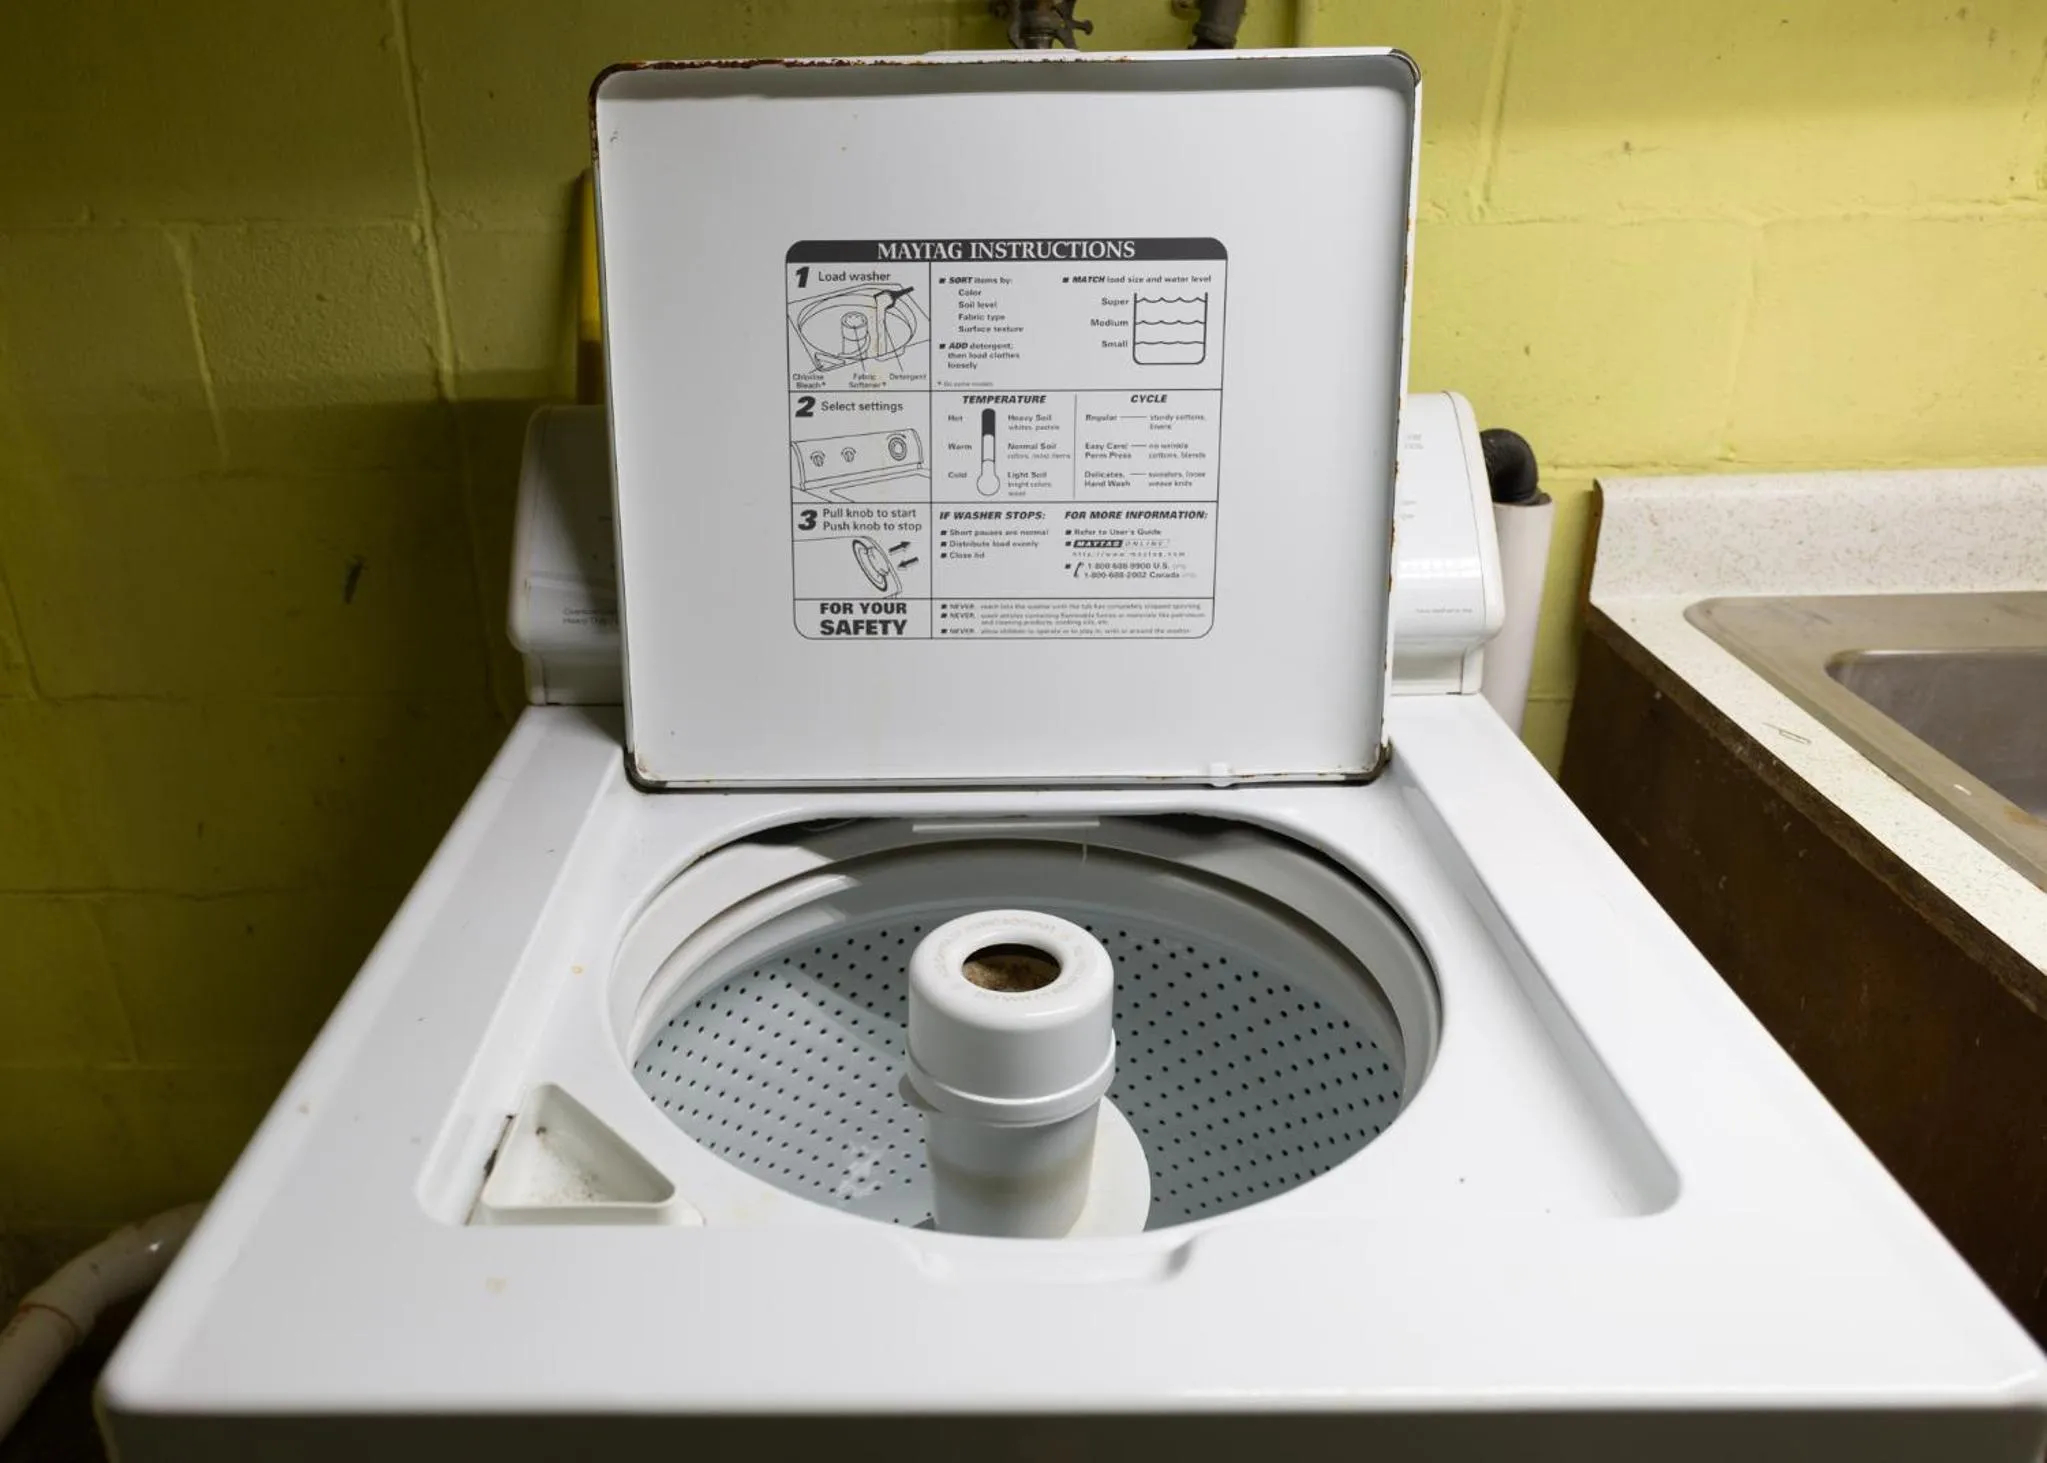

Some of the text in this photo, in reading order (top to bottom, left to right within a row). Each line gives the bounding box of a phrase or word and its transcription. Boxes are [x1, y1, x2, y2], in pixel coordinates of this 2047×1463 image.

[877, 241, 1136, 260] MAYTAG INSTRUCTIONS
[796, 266, 891, 288] 1 Load washer
[948, 276, 973, 284] SORT
[1102, 297, 1129, 306] Super
[987, 314, 1006, 322] type
[1090, 319, 1128, 327] Medium
[948, 342, 968, 350] ADD
[1102, 340, 1128, 348] Small
[948, 362, 978, 370] loosely
[889, 373, 927, 381] Detergent
[962, 395, 1047, 404] TEMPERATURE
[1130, 394, 1168, 403] CYCLE
[795, 396, 904, 418] 2 Select settings
[1008, 414, 1033, 422] Heavy
[1085, 414, 1118, 422] Regular
[1085, 442, 1104, 450] Easy
[798, 508, 916, 530] 3 Pull knob to start
[940, 511, 1046, 520] IF WASHER STOPS:
[1064, 510, 1208, 520] FOR MORE INFORMATION:
[822, 522, 922, 533] Push knob to stop
[1075, 540, 1122, 548] MAYTAG
[820, 602, 908, 614] FOR YOUR
[820, 620, 908, 636] SAFETY
